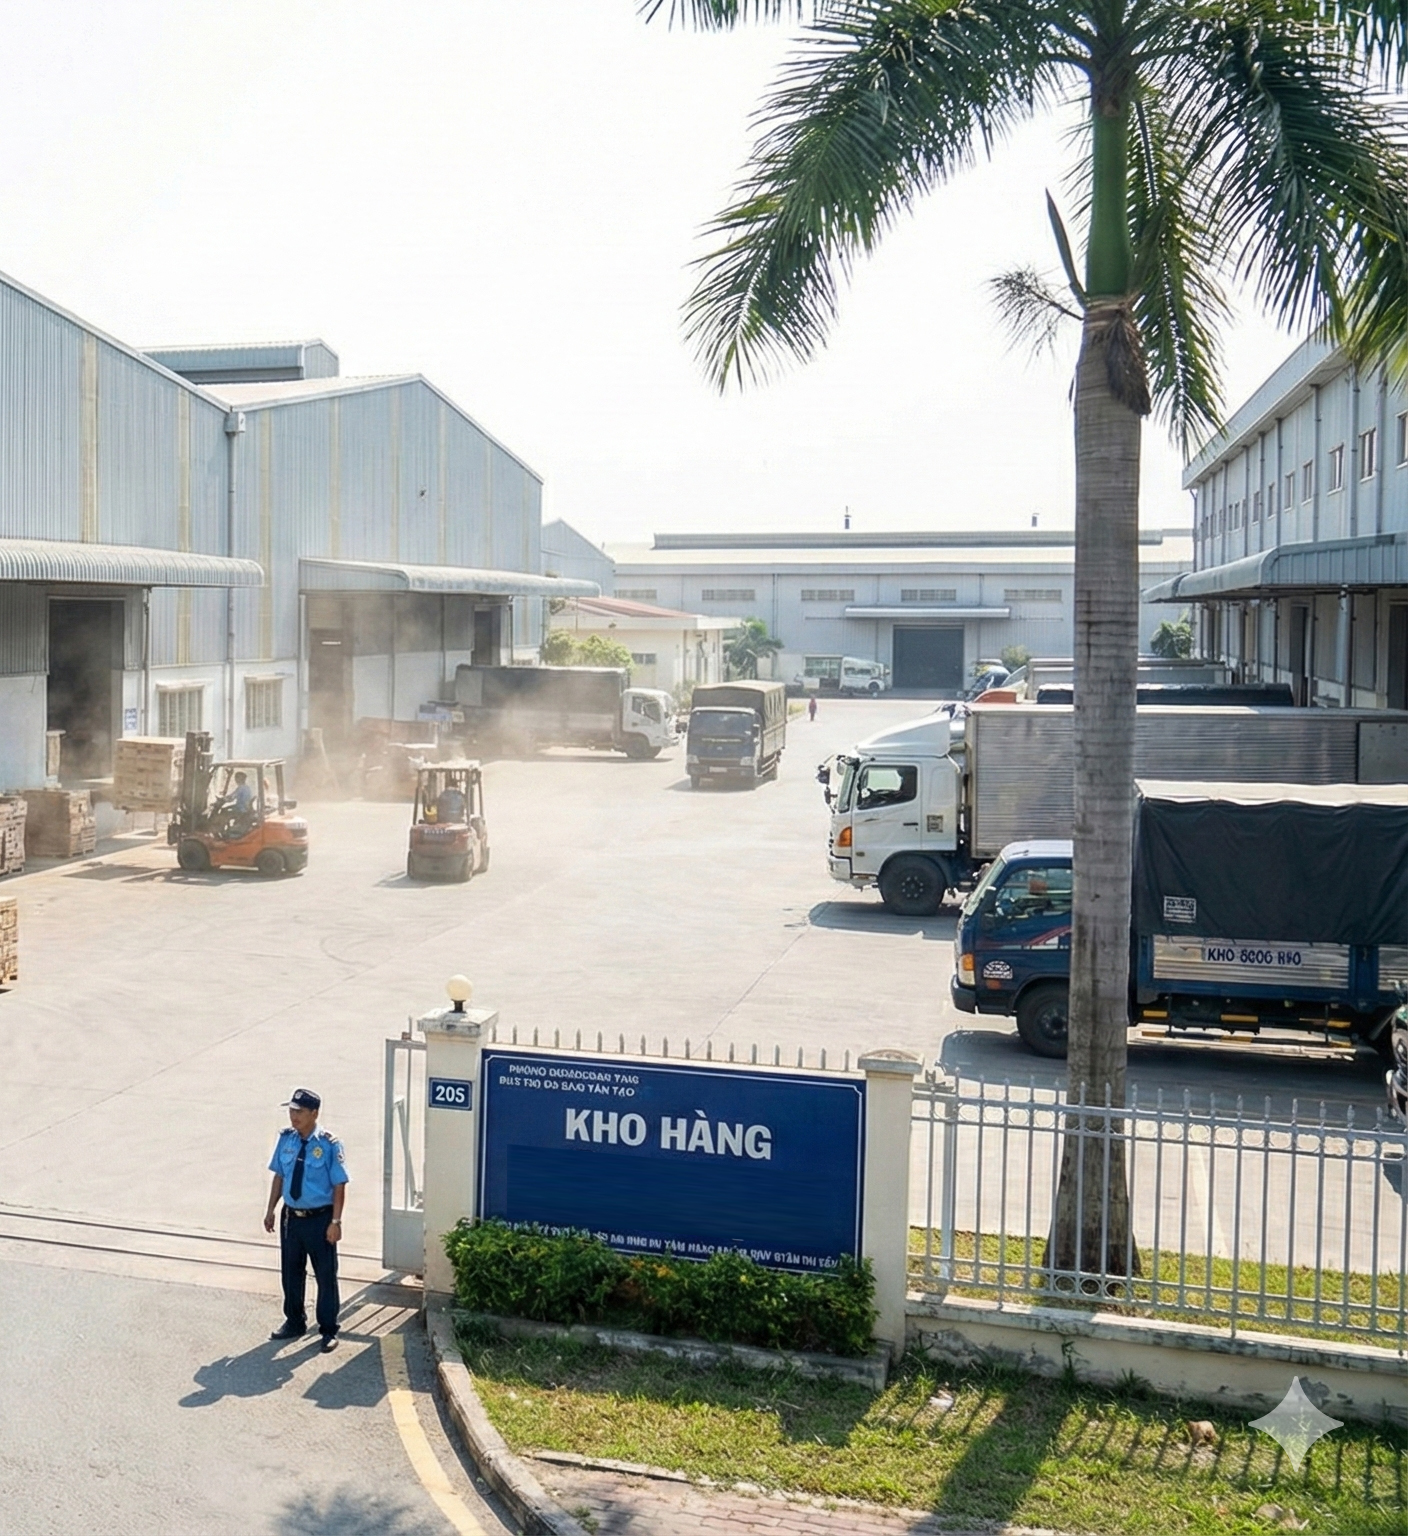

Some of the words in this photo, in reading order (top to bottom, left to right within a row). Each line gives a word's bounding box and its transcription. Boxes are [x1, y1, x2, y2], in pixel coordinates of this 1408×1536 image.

[1207, 948, 1235, 961] KHO
[565, 1108, 647, 1146] KHO
[660, 1109, 772, 1160] HÀNG
